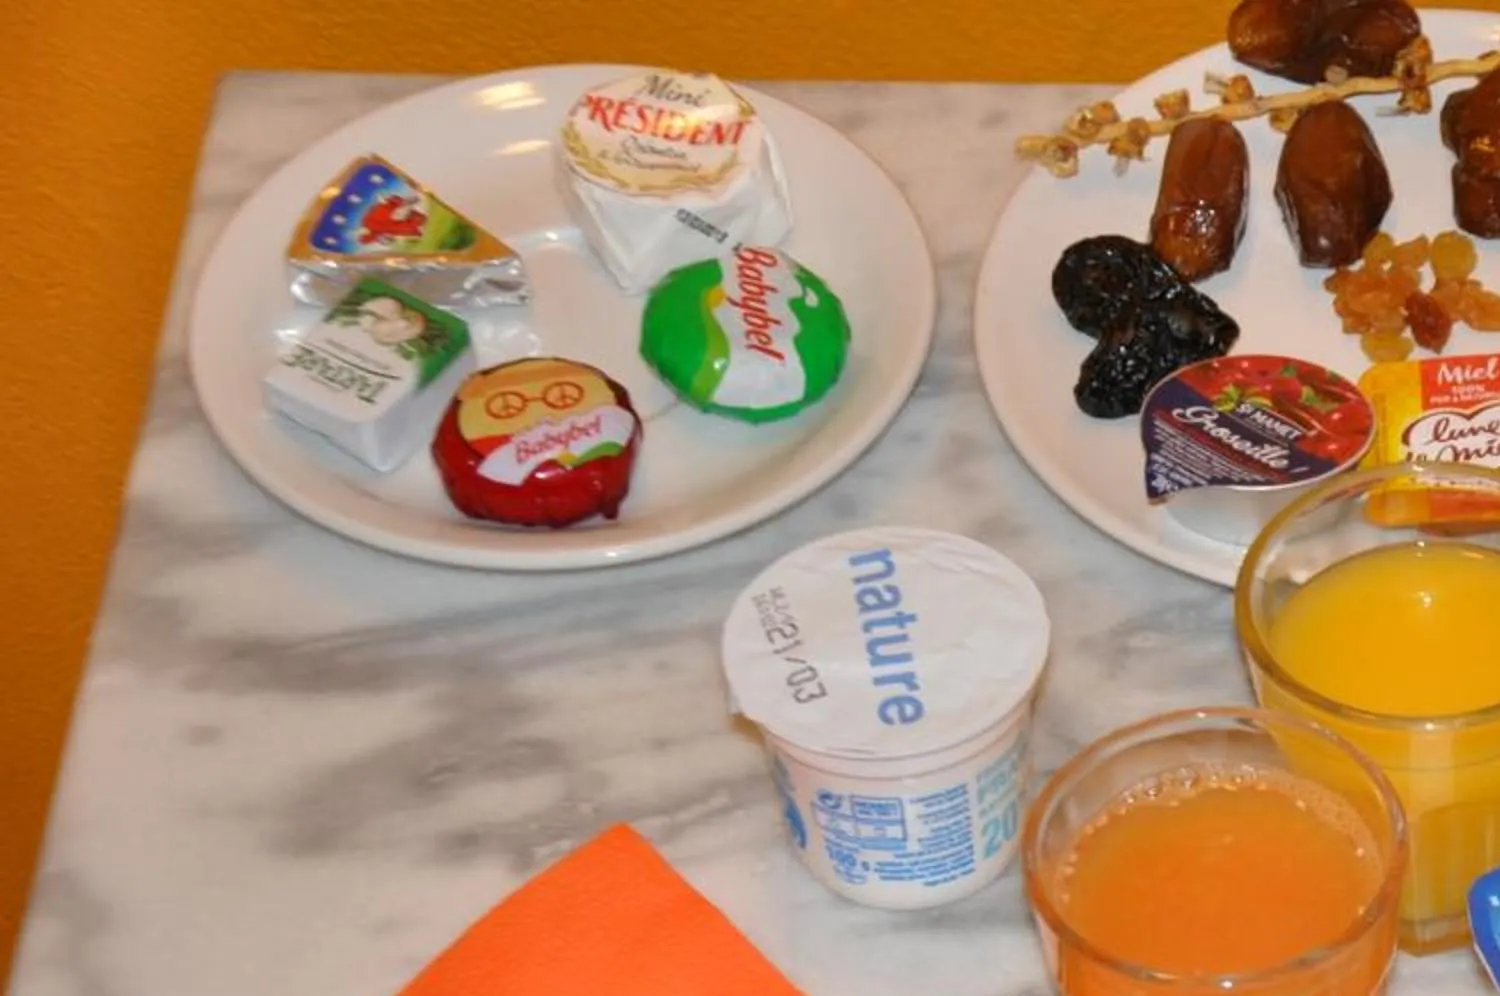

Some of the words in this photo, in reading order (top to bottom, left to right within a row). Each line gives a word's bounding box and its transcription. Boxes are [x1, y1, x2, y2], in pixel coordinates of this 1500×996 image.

[637, 74, 711, 106] Mini
[725, 247, 785, 360] Babybel
[279, 345, 388, 405] TARTARE
[1437, 356, 1500, 386] Miel
[516, 414, 602, 464] Babybel
[1172, 405, 1289, 469] Groseille
[766, 622, 829, 704] 21/03
[848, 549, 925, 726] nature
